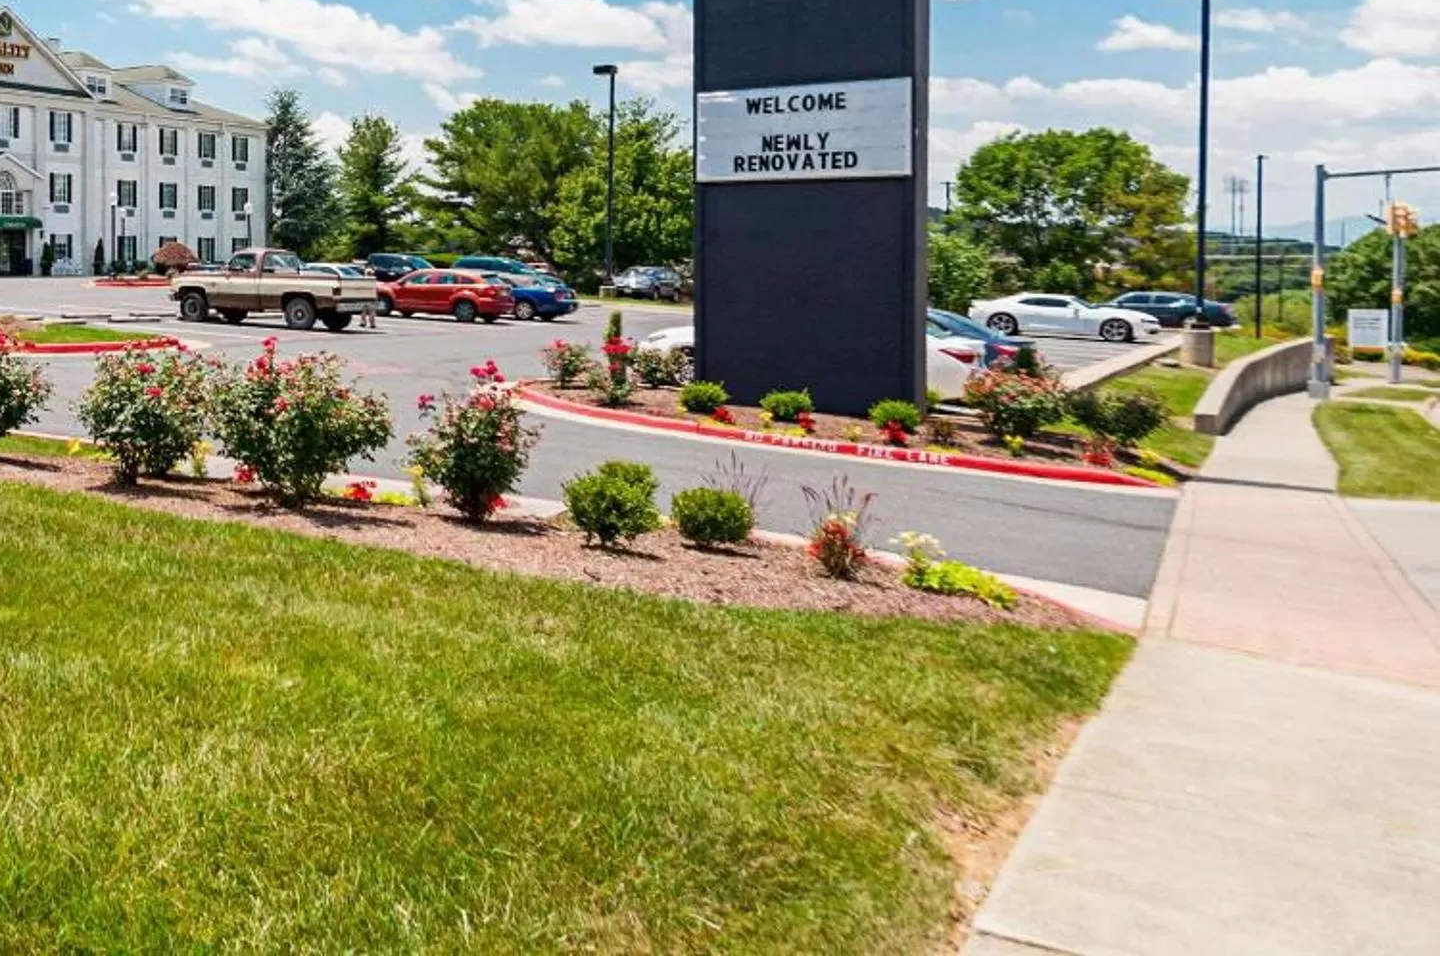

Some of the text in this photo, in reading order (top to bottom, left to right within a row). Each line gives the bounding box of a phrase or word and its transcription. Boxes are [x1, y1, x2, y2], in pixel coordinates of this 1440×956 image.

[746, 92, 847, 114] WELCOME
[762, 132, 830, 152] NEWLY
[733, 151, 858, 173] RENOVATED
